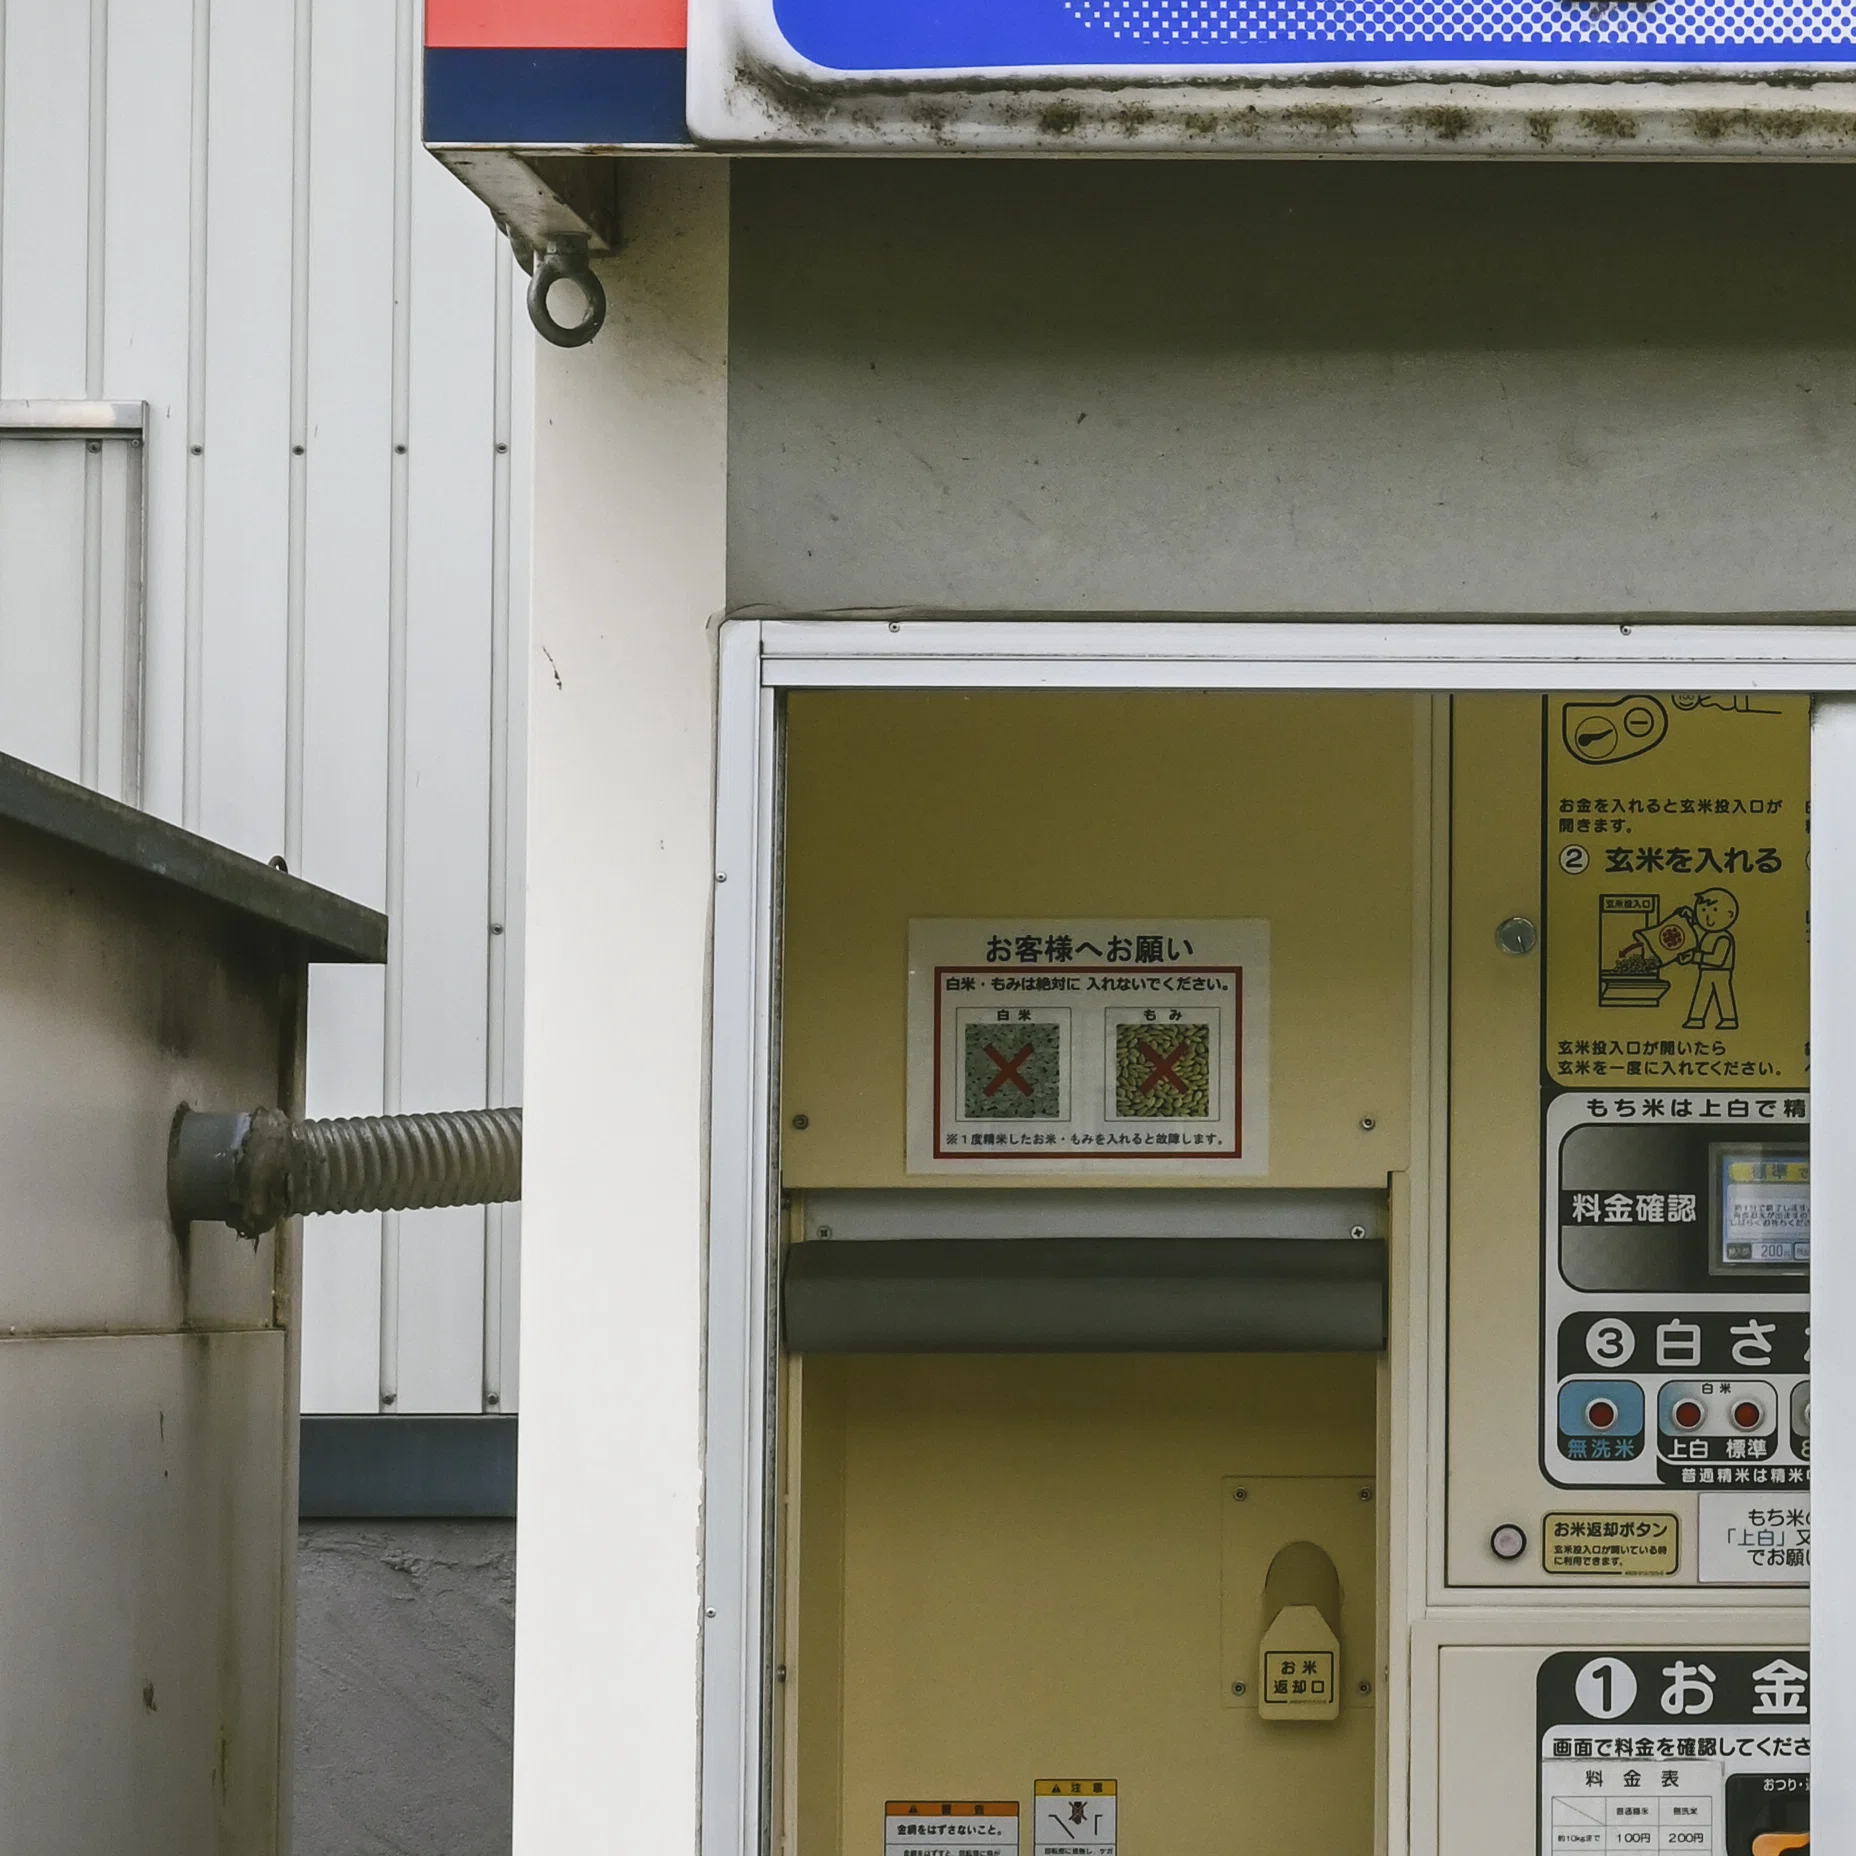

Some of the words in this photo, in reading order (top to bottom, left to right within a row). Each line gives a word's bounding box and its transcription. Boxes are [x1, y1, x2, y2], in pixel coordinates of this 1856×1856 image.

[1558, 798, 1783, 815] お金を入れると玄米投入口が
[1558, 819, 1633, 834] 開きます。
[1605, 846, 1783, 875] 玄米を入れる
[985, 934, 1194, 964] お客様へお願い
[1558, 1040, 1727, 1057] 玄米投入口が開いたら
[1558, 1060, 1783, 1077] 玄米を一度に入れてください。
[1571, 1193, 1697, 1224] 料金確認
[1701, 1382, 1732, 1395] 白米
[1567, 1439, 1636, 1459] 無洗米
[1667, 1438, 1709, 1459] 上白
[1725, 1438, 1768, 1460] 標準
[1553, 1521, 1669, 1539] お米返却ボタン
[1280, 1660, 1318, 1675] お米
[1273, 1680, 1325, 1695] 返却口
[1585, 1769, 1680, 1788] 料金表
[1616, 1832, 1651, 1844] 100円
[1668, 1832, 1704, 1844] 200円
